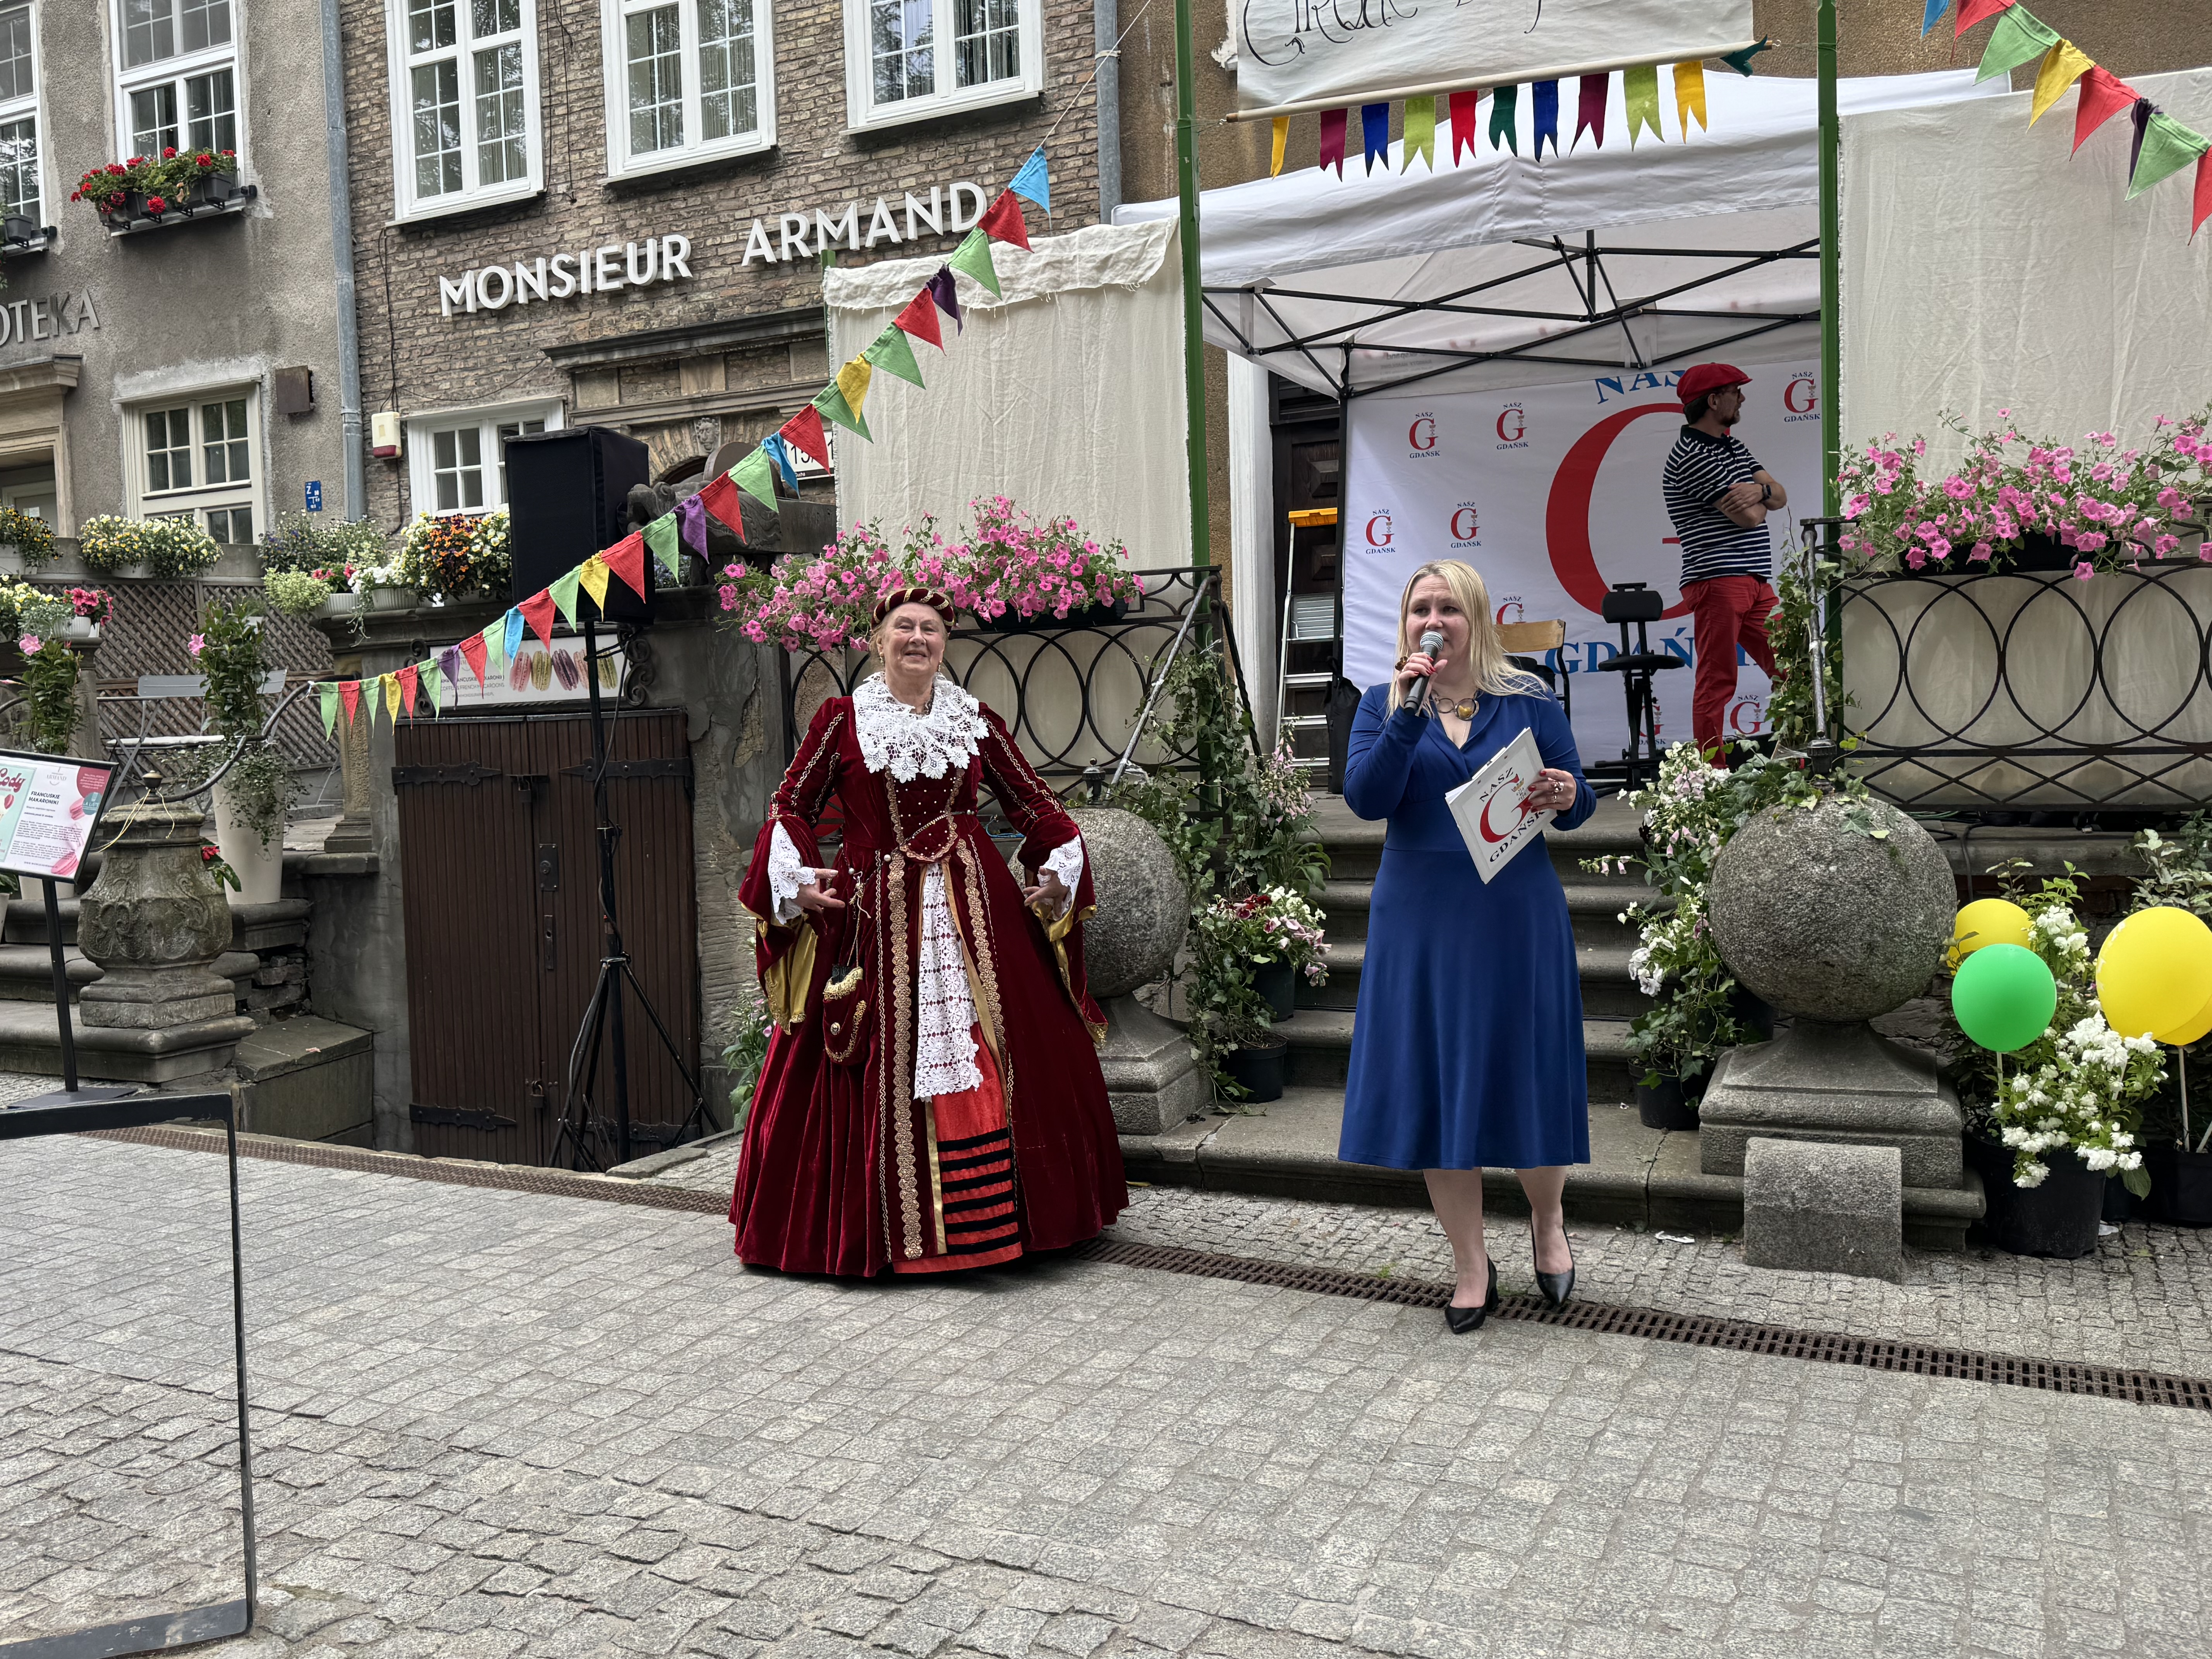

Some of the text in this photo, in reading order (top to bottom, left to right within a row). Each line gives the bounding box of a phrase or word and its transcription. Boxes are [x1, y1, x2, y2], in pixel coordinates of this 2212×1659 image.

[440, 182, 987, 317] MONSIEUR ARMAND
[1792, 371, 1813, 380] NASZ
[1595, 370, 1686, 404] NAS
[1784, 413, 1820, 422] GDAŃSK
[1496, 441, 1529, 450] GDAŃSK
[1409, 450, 1440, 459] GDAŃSK
[1451, 540, 1481, 549] GDAŃSK
[1479, 767, 1514, 802] NASZ
[1489, 810, 1547, 863] GDAŃSK
